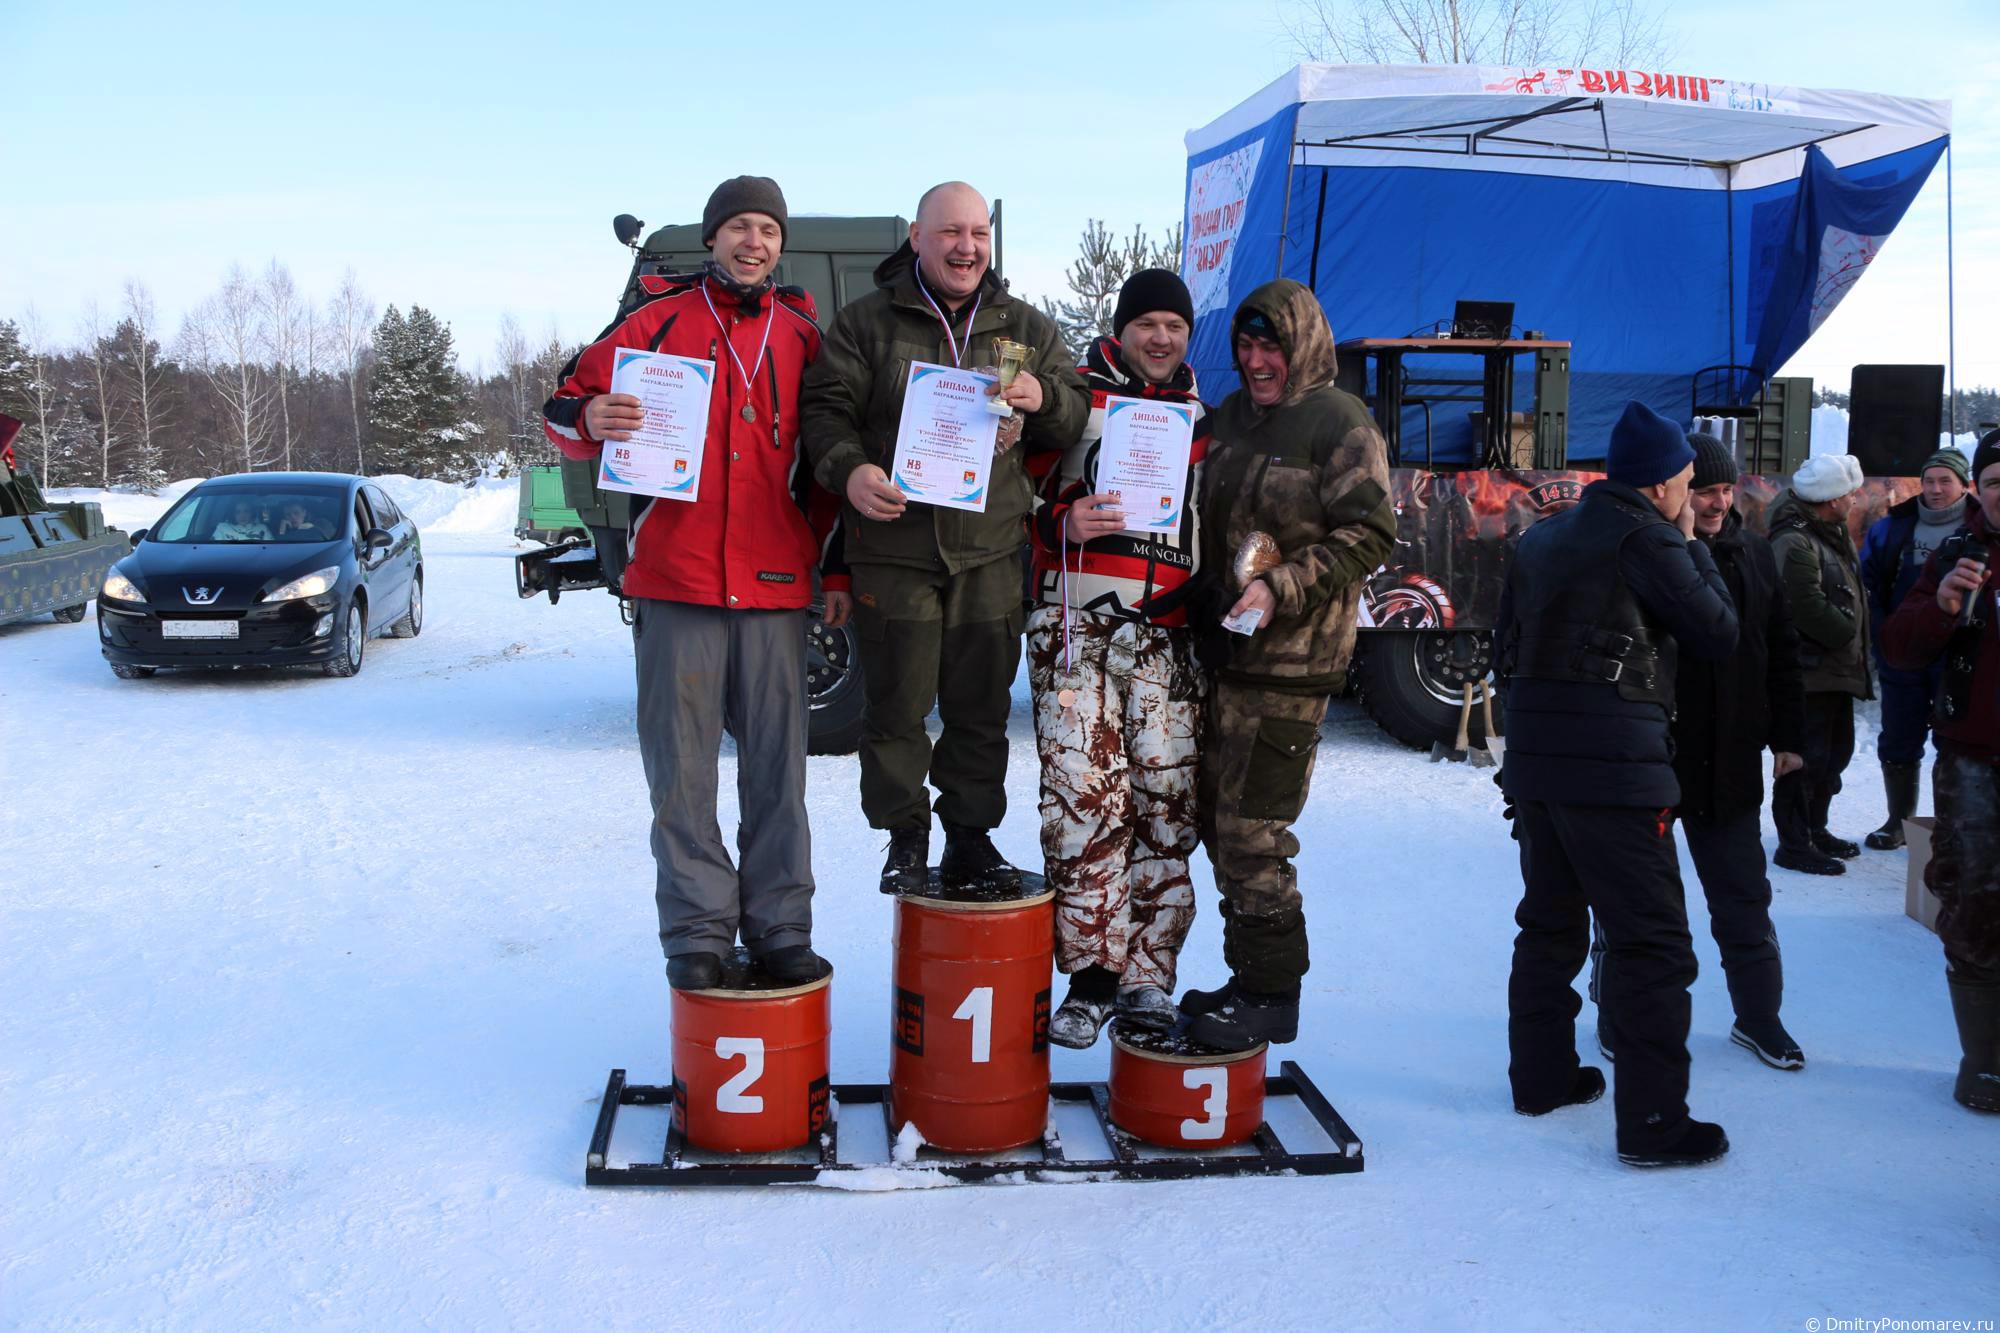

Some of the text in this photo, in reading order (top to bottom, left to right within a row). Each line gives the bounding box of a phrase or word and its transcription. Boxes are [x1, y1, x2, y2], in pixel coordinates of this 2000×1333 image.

[642, 366, 684, 380] ДИПЛОМ
[935, 379, 976, 394] ДИПЛОМ
[1131, 412, 1169, 424] ДИПЛОМ
[952, 986, 993, 1063] 1
[715, 1036, 765, 1114] 2
[1181, 1066, 1228, 1140] 3
